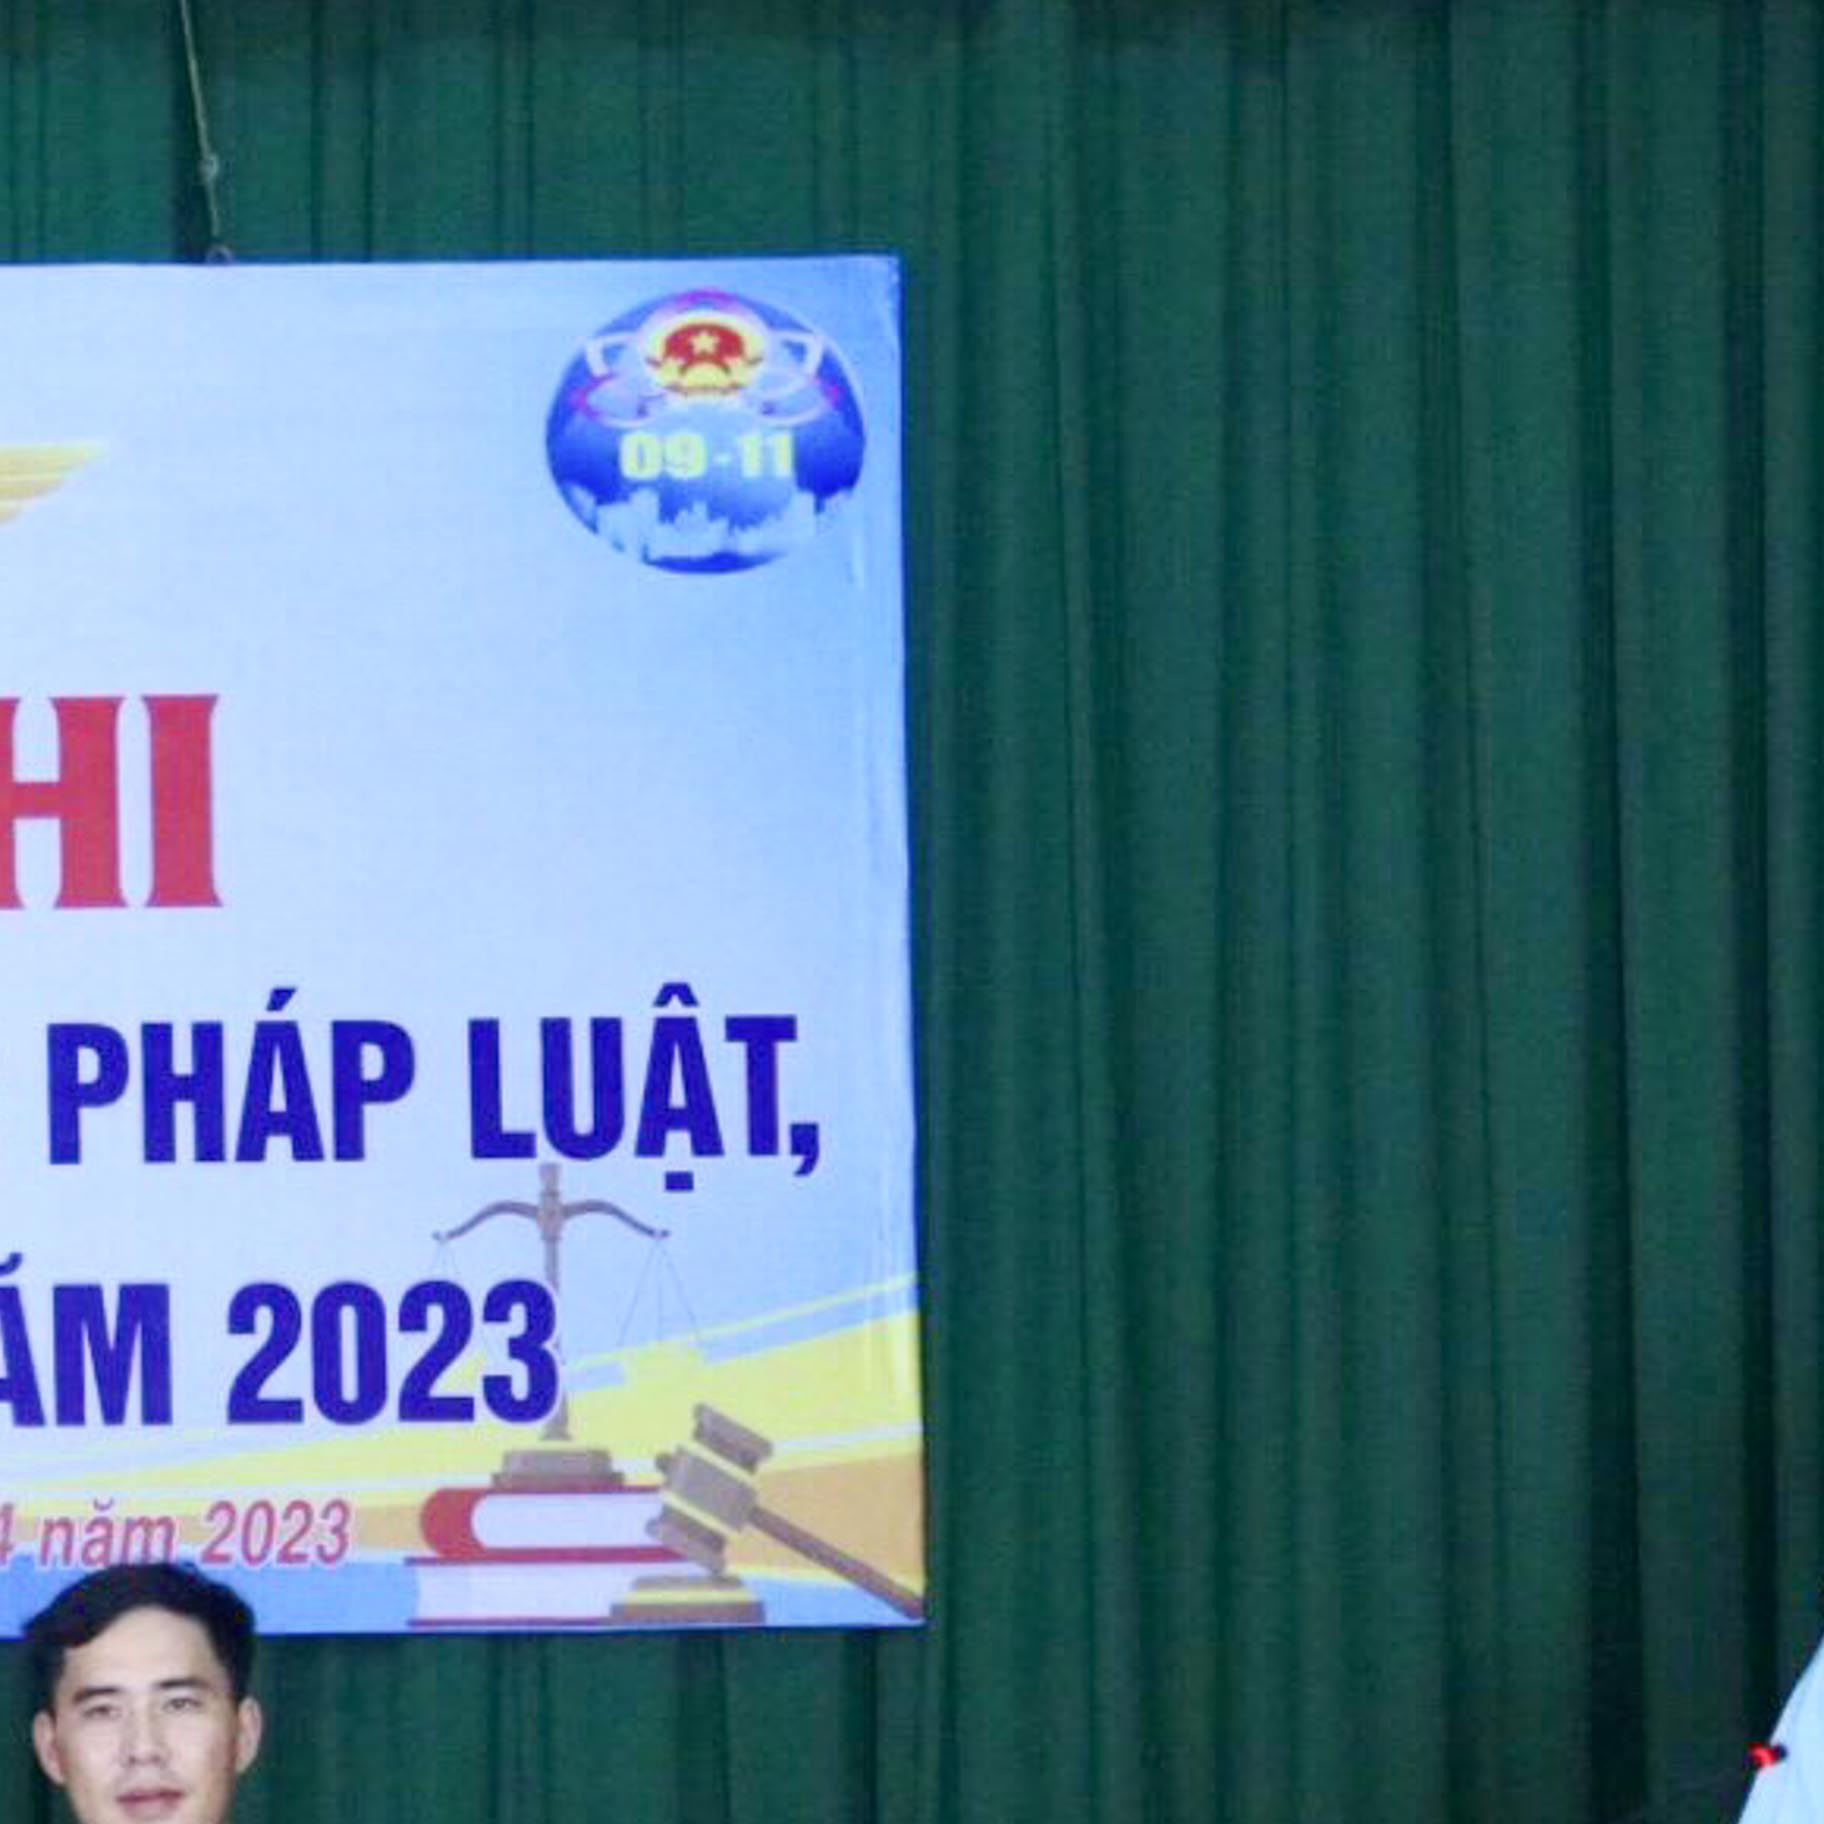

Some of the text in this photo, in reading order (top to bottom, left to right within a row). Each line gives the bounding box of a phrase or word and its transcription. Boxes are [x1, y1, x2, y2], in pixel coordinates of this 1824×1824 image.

[45, 985, 417, 1167] PHÁP
[466, 980, 822, 1194] LUẬT,
[225, 1277, 560, 1427] 2023
[40, 1497, 178, 1567] năm
[201, 1498, 351, 1566] 2023
